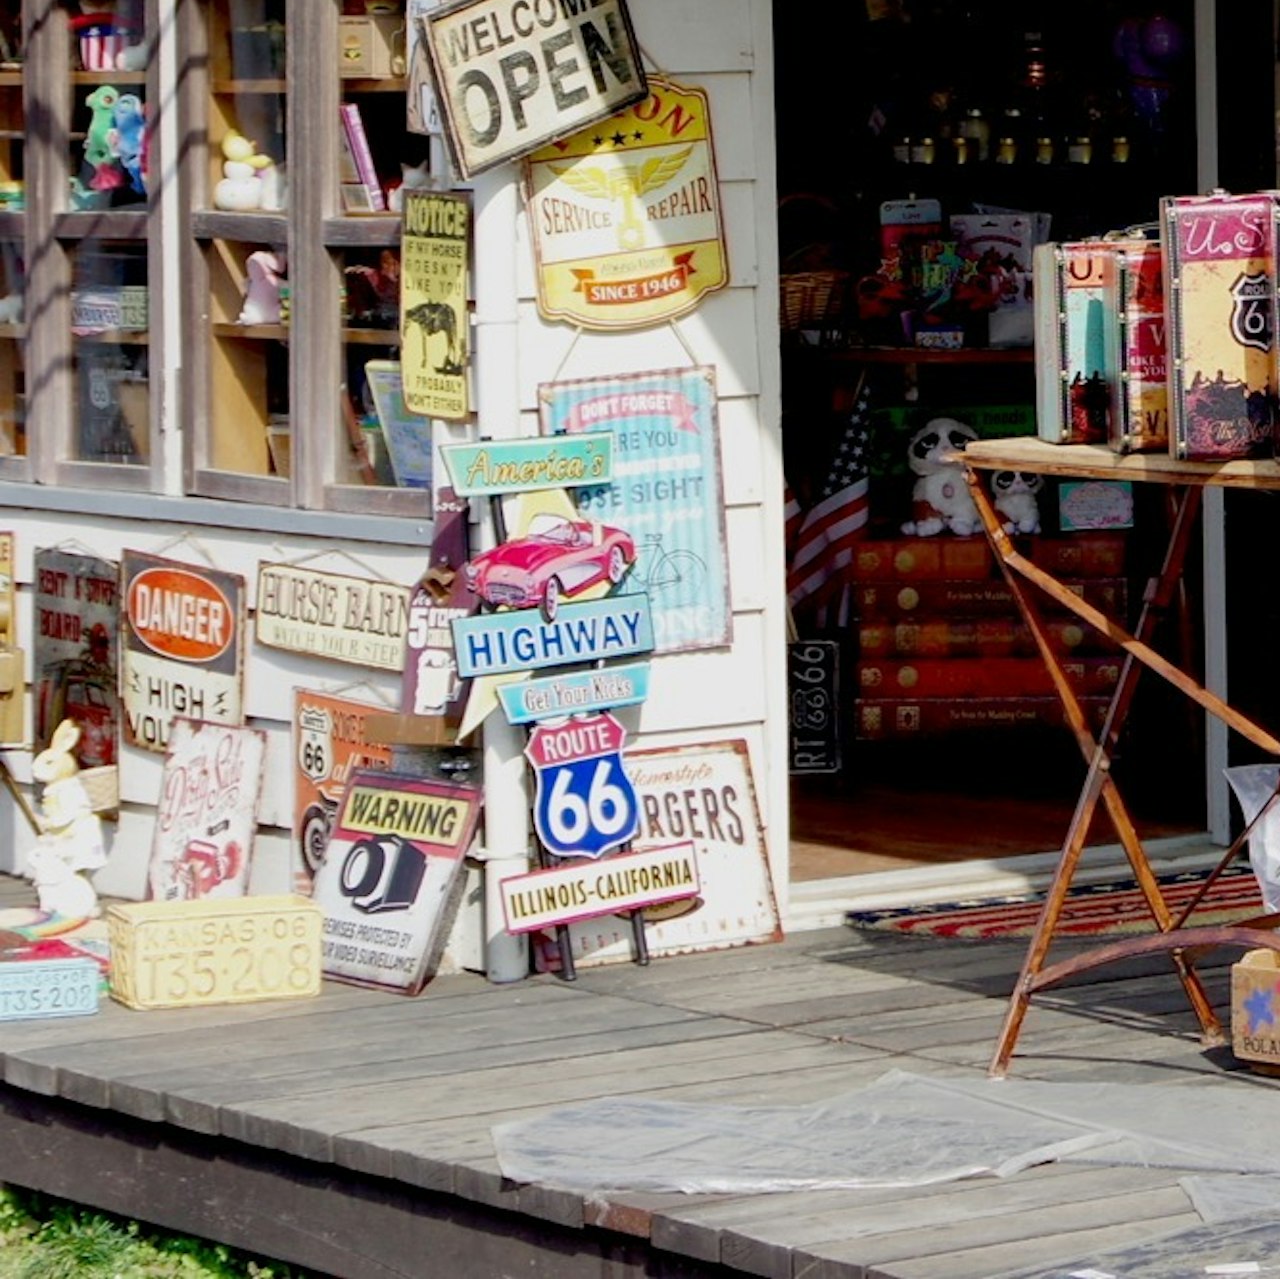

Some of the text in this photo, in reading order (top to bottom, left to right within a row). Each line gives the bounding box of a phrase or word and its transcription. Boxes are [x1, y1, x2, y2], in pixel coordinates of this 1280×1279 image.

[455, 11, 634, 150] OPEN
[405, 197, 468, 237] NOTICE
[540, 175, 714, 236] SERVICE REPAIR
[591, 273, 682, 303] SINCE 1946
[581, 394, 676, 420] DON'T FORGET
[643, 430, 679, 449] YOU
[467, 441, 605, 487] America's
[631, 476, 704, 505] SIGHT
[134, 583, 227, 649] DANGER
[262, 572, 338, 629] HORSE
[467, 611, 642, 669] HIGHWAY
[147, 677, 205, 714] HIGH
[524, 675, 633, 711] Get Your Kicks
[302, 742, 325, 773] 66
[542, 722, 614, 762] ROUTE
[349, 789, 459, 840] WARNING
[548, 760, 631, 845] 66
[511, 858, 694, 919] ILLINOIS-CALIFORNIA
[356, 922, 399, 948] PROTECTED
[335, 941, 417, 975] VIDEO SURVEILLANCE
